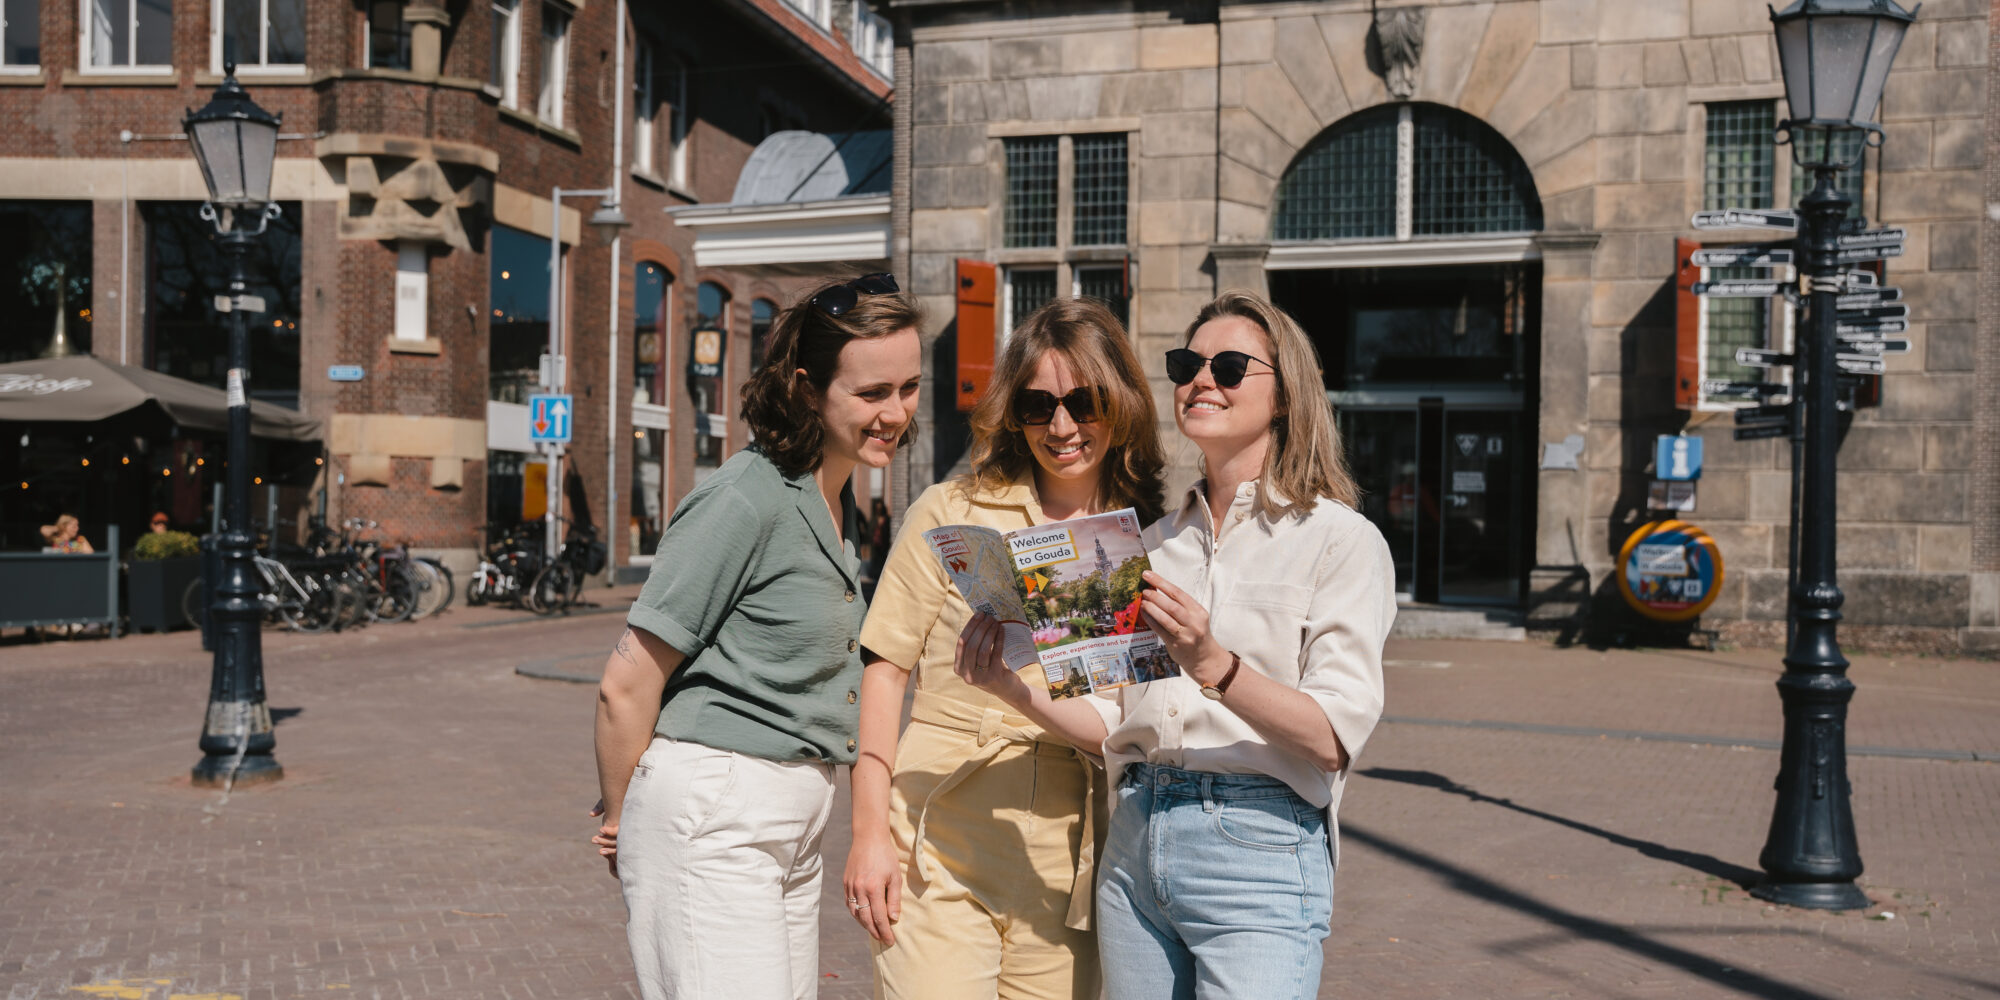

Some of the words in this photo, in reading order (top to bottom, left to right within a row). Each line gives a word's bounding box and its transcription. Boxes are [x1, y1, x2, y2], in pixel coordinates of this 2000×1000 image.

[932, 533, 949, 541] Map
[1013, 533, 1065, 549] Welcome
[1019, 557, 1031, 565] to
[1034, 547, 1071, 561] Gouda
[1042, 650, 1068, 661] Explore,
[1070, 642, 1105, 653] experience
